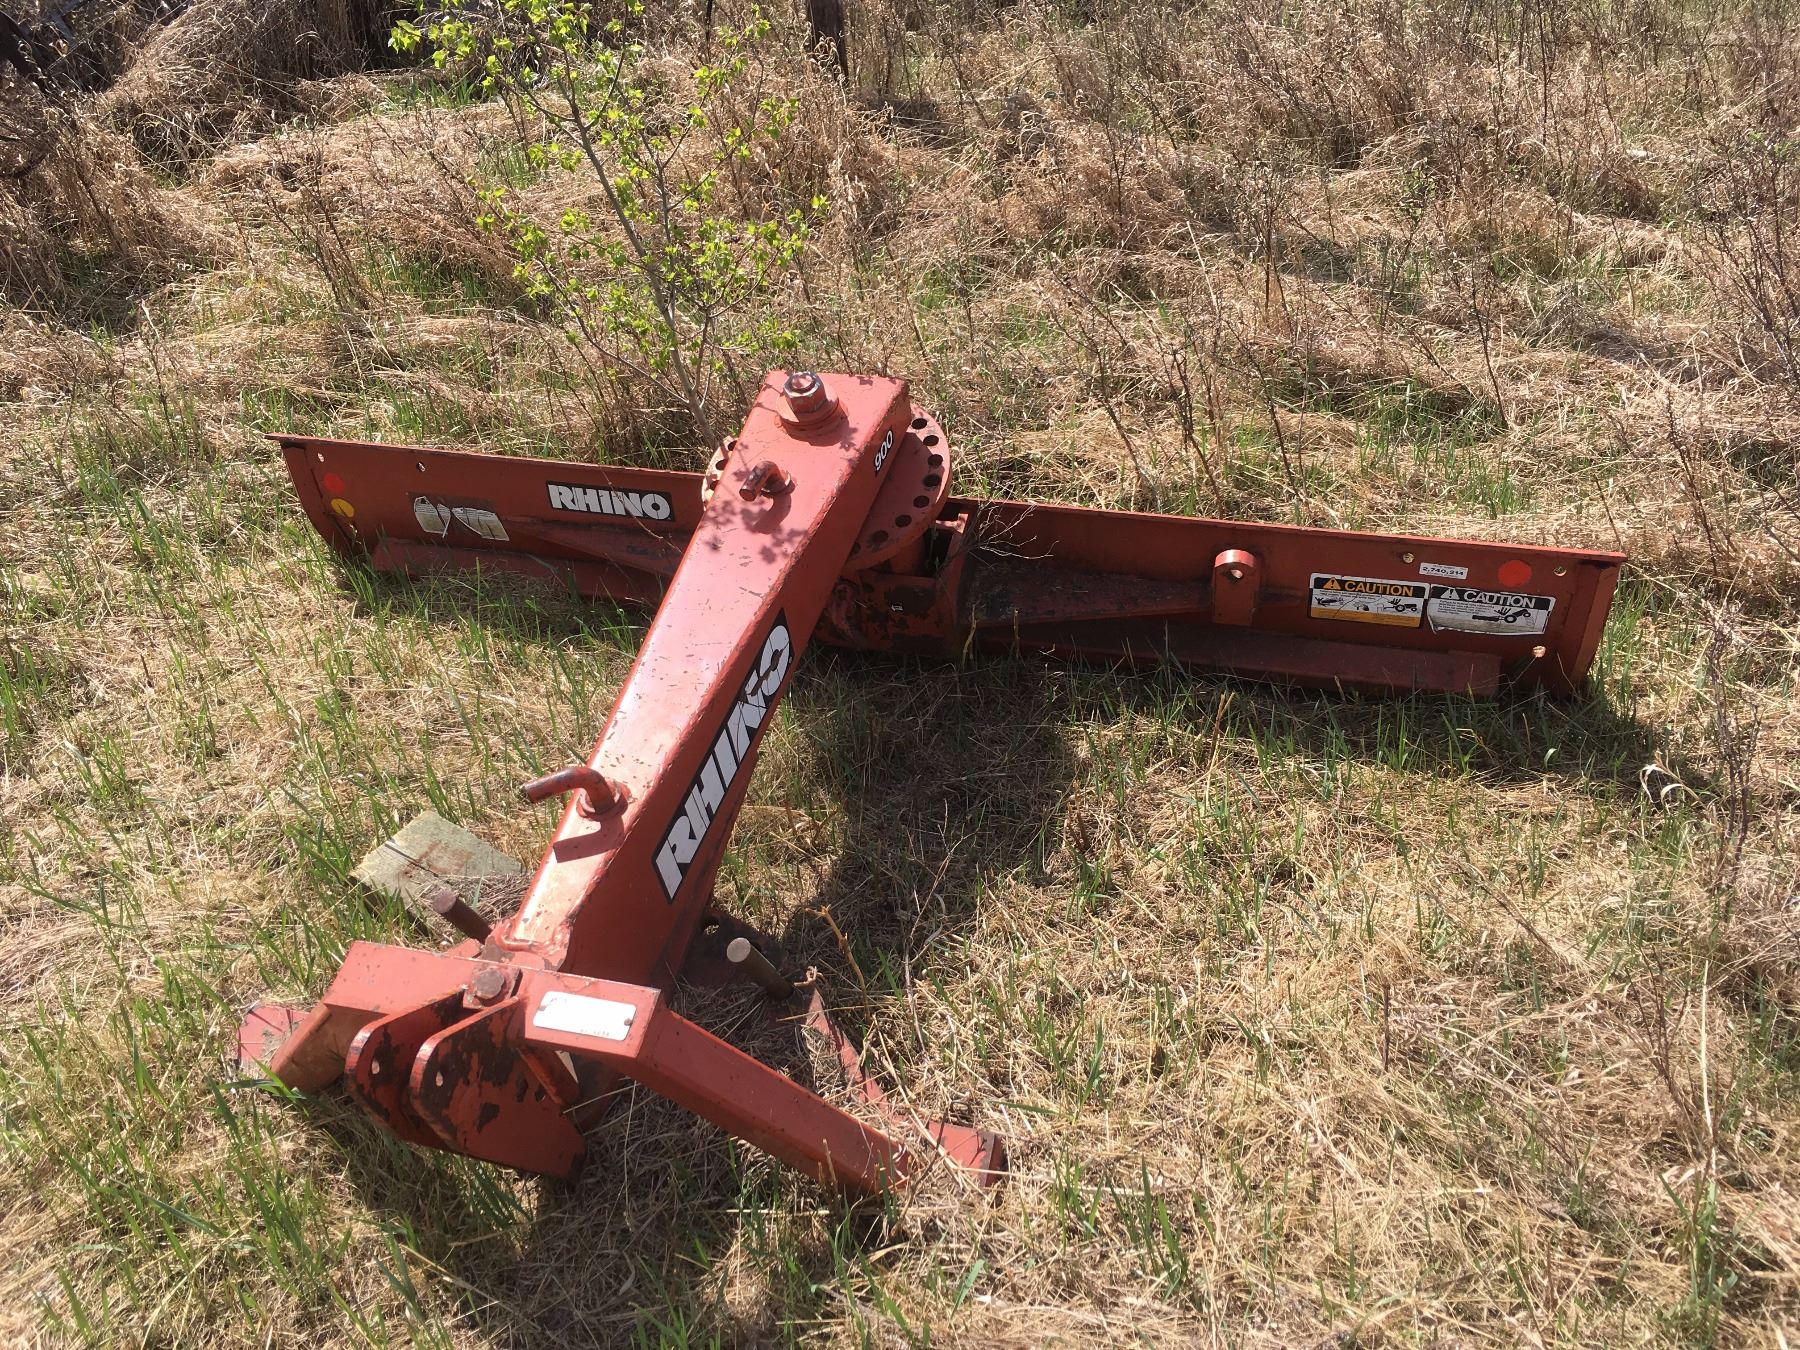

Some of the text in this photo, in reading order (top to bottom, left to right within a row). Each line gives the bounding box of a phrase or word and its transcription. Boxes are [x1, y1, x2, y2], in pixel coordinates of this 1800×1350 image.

[874, 430, 893, 471] 900
[547, 484, 671, 520] RHINO
[1344, 581, 1414, 597] CAUTION
[1463, 590, 1536, 609] CAUTION
[655, 625, 791, 900] RHINO
